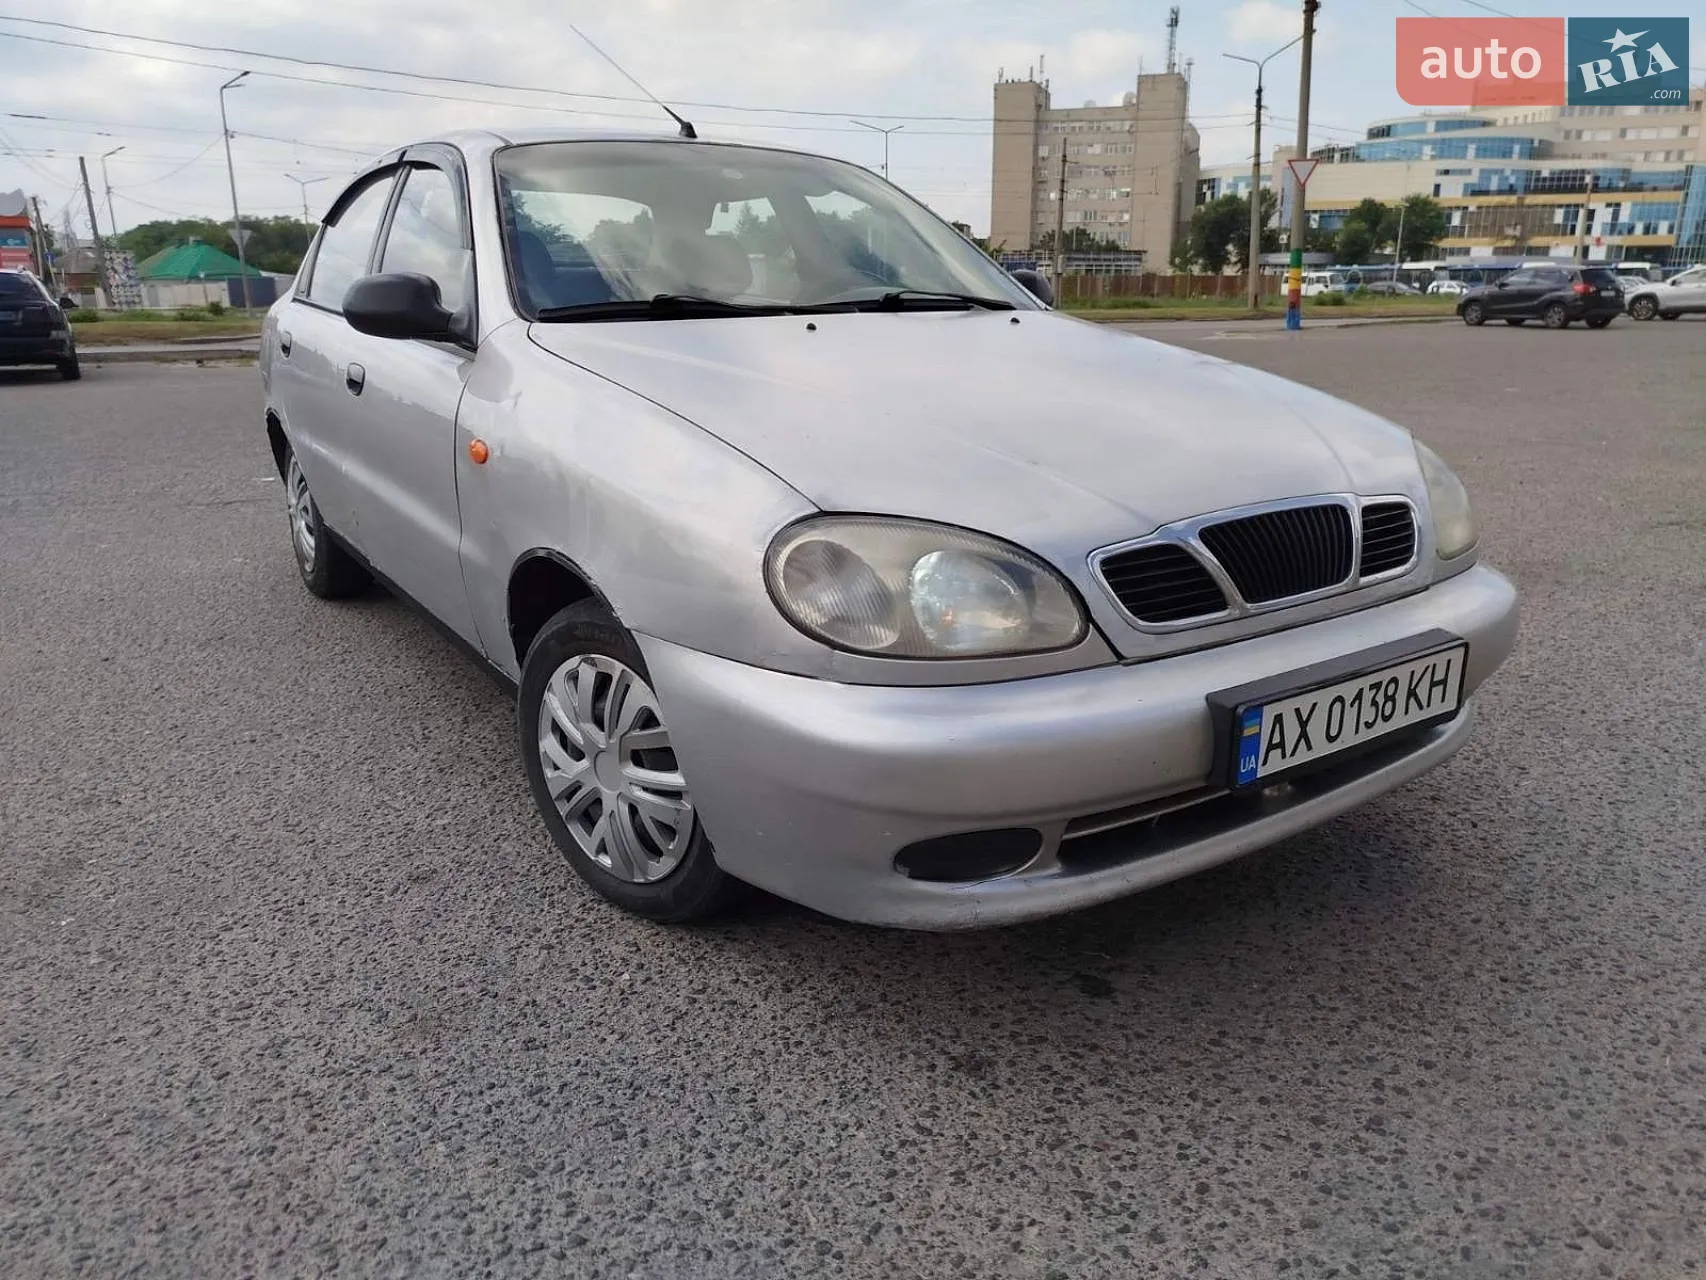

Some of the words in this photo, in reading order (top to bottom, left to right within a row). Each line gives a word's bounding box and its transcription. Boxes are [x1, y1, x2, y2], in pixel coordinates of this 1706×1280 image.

[1261, 701, 1318, 766] AX
[1325, 676, 1400, 743] 0138
[1404, 659, 1452, 715] KH
[1240, 753, 1257, 773] UA
